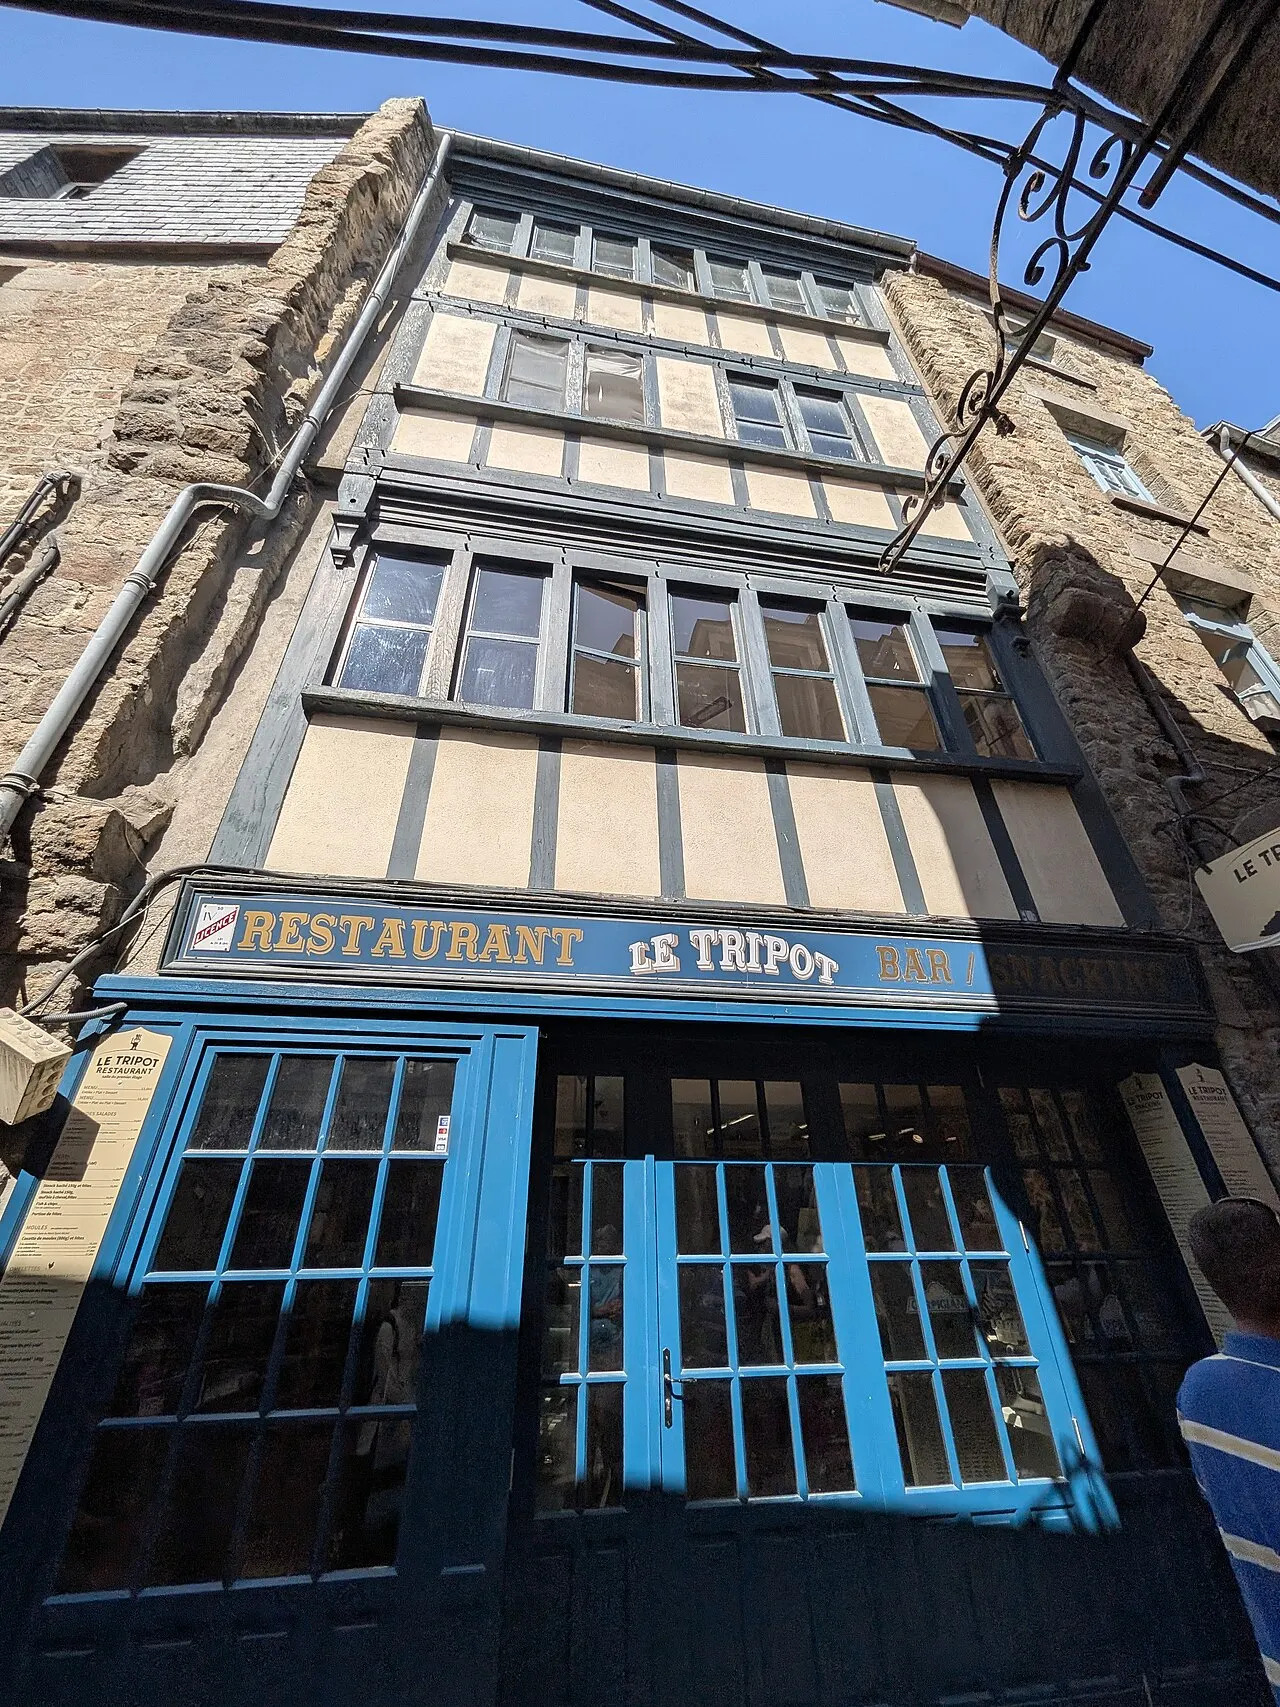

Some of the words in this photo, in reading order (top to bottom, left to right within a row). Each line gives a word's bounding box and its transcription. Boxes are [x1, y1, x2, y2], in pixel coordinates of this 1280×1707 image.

[1233, 859, 1258, 883] LE
[196, 911, 236, 942] LICENCE
[237, 909, 585, 967] RESTAURANT
[628, 933, 680, 976] LE
[691, 929, 839, 985] TRIPOT
[876, 945, 953, 985] BAR
[96, 1056, 112, 1066] LE
[116, 1055, 159, 1067] TRIPOT
[96, 1066, 154, 1075] RESTAURANT
[1136, 1091, 1163, 1103] TRIPOT
[1188, 1086, 1198, 1095] LE
[1198, 1086, 1227, 1096] TRIPOT
